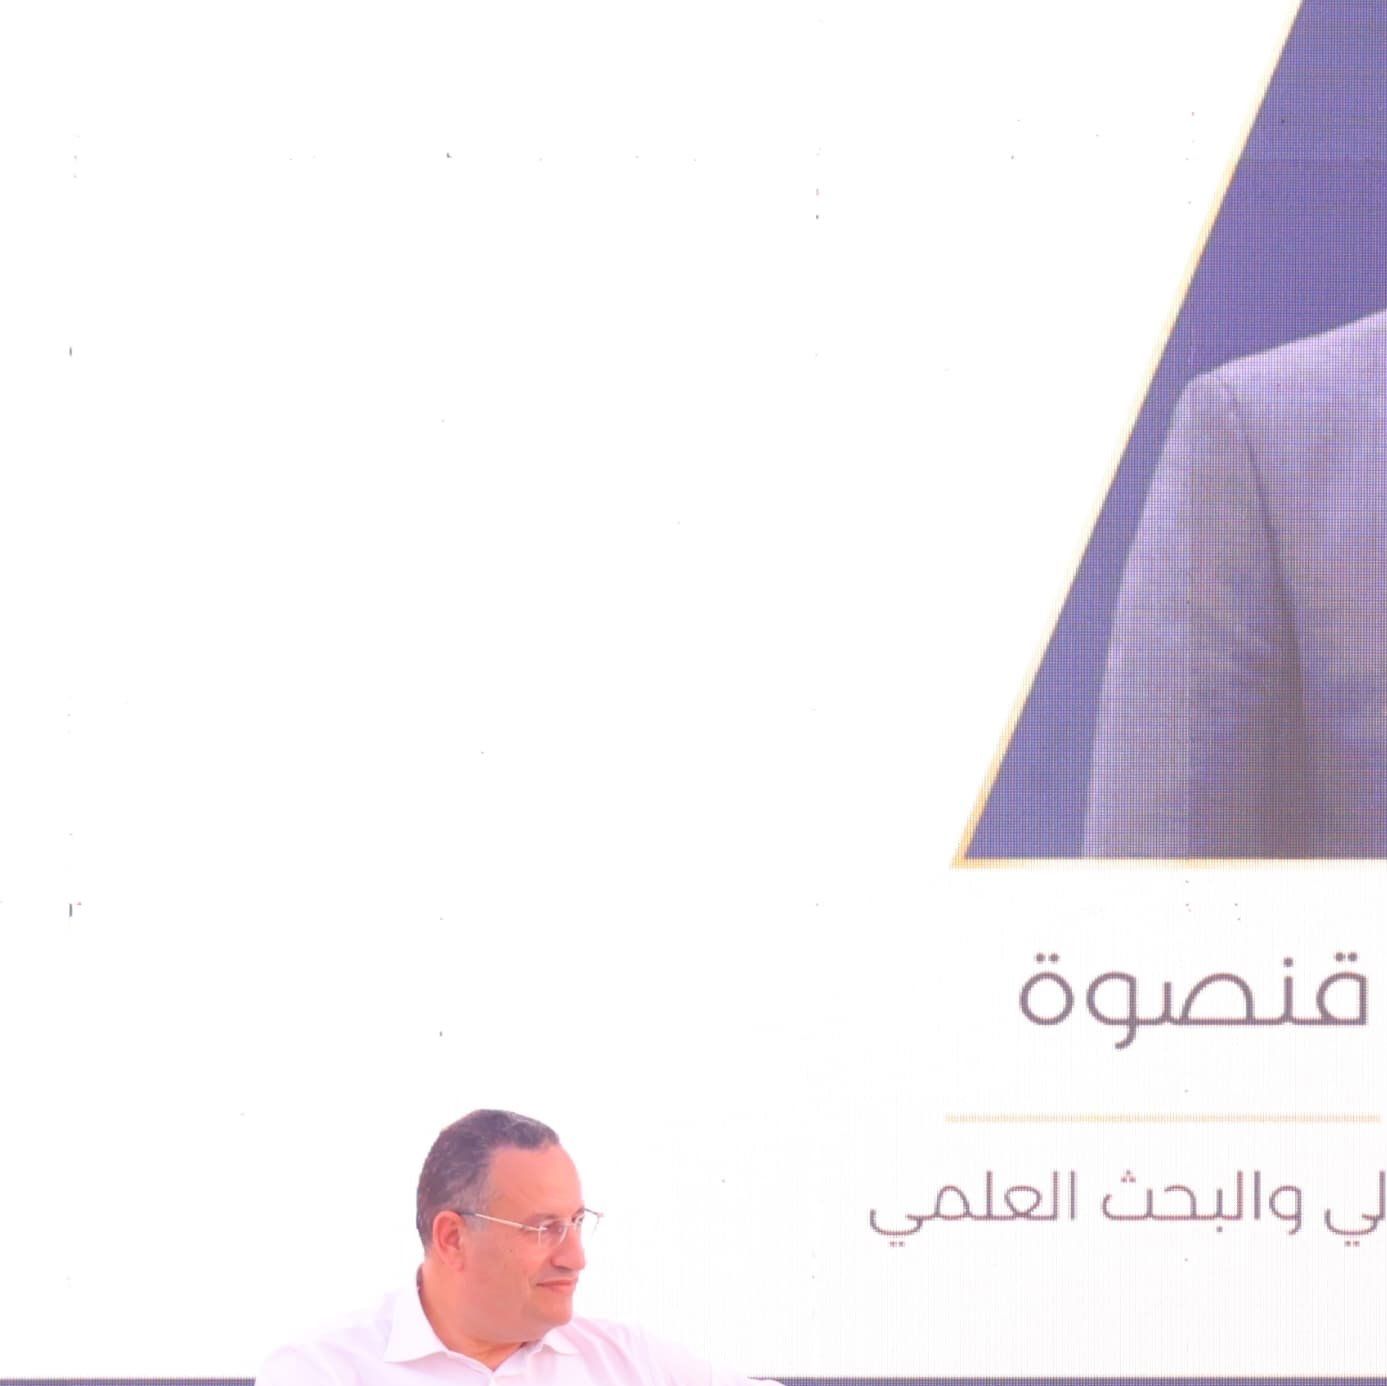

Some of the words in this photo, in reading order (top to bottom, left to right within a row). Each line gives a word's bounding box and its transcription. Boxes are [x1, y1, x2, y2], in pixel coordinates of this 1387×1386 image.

[1018, 951, 1368, 1050] قنصوة
[869, 1170, 1076, 1247] العلمي
[1101, 1169, 1303, 1236] والبحث
